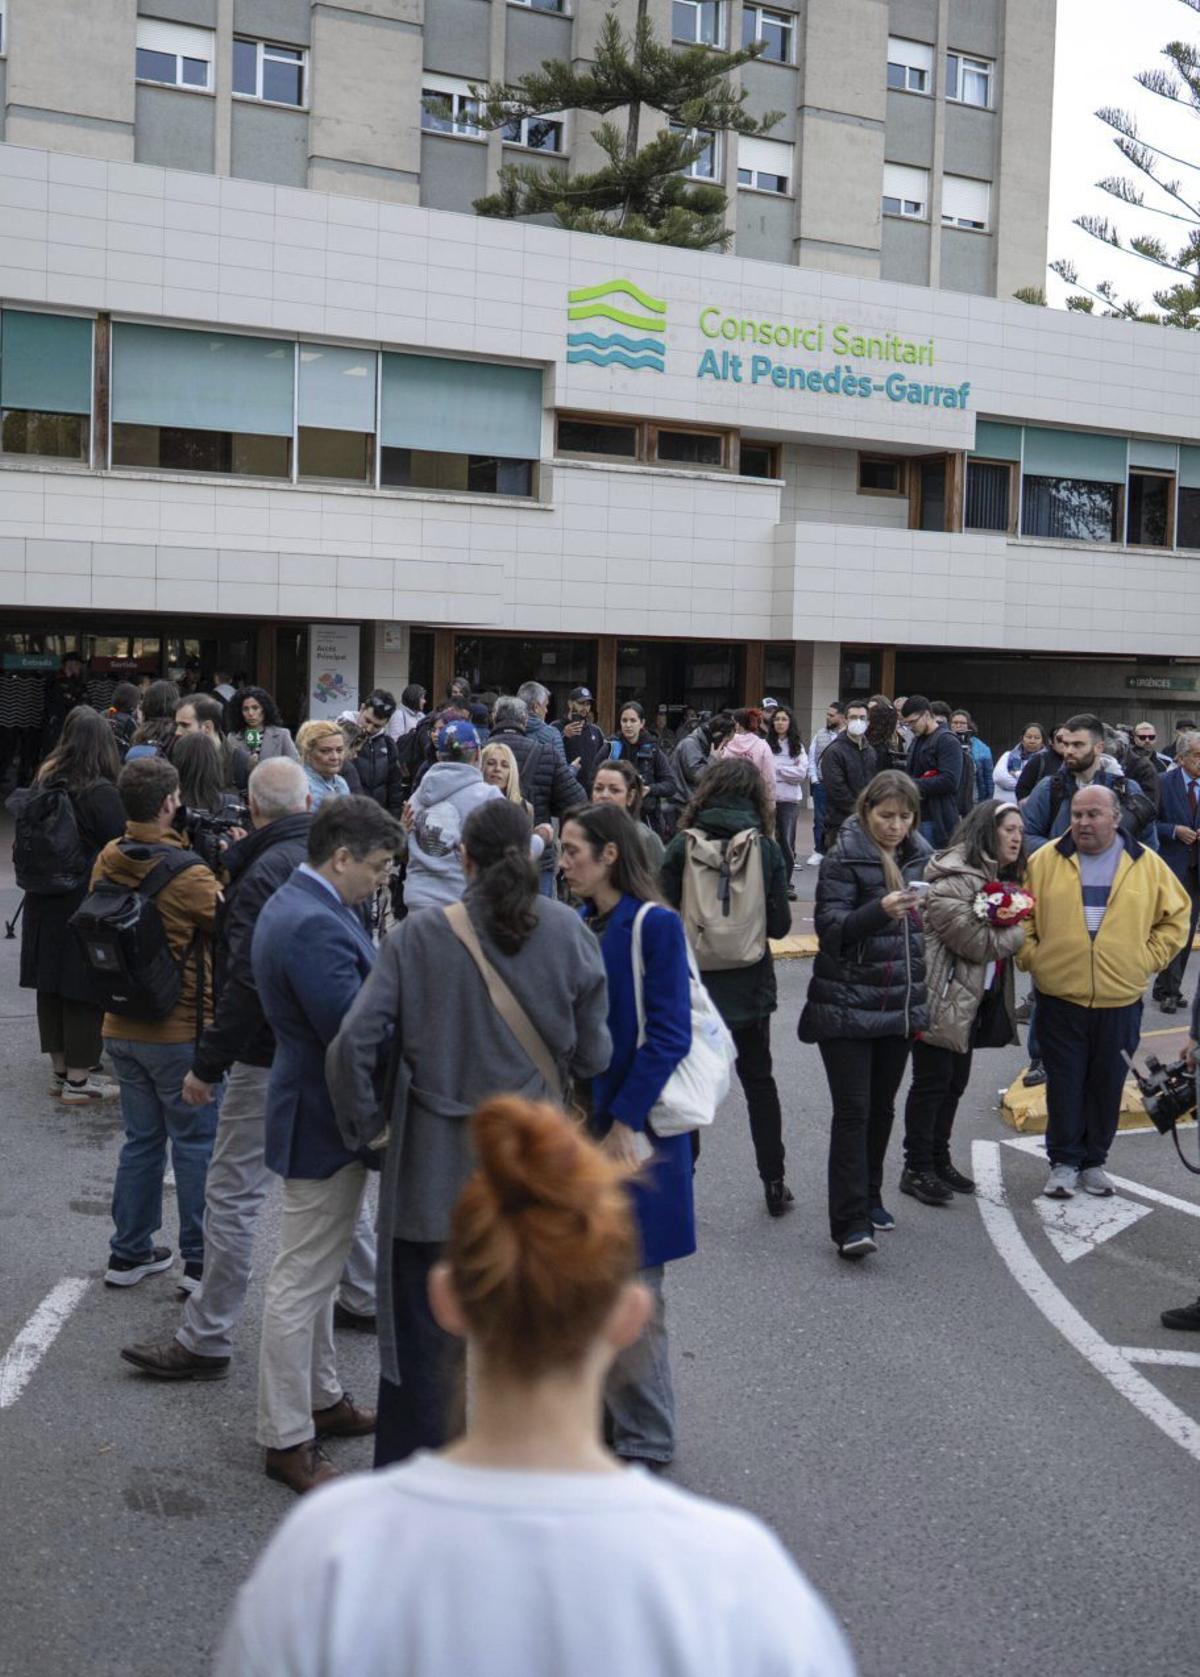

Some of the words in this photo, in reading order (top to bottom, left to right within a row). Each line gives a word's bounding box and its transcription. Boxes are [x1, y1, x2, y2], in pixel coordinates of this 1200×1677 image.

[699, 306, 825, 352] Consorci
[831, 325, 935, 366] Sanitari
[697, 349, 743, 383] Alt
[751, 355, 970, 409] Penedès-Garraf
